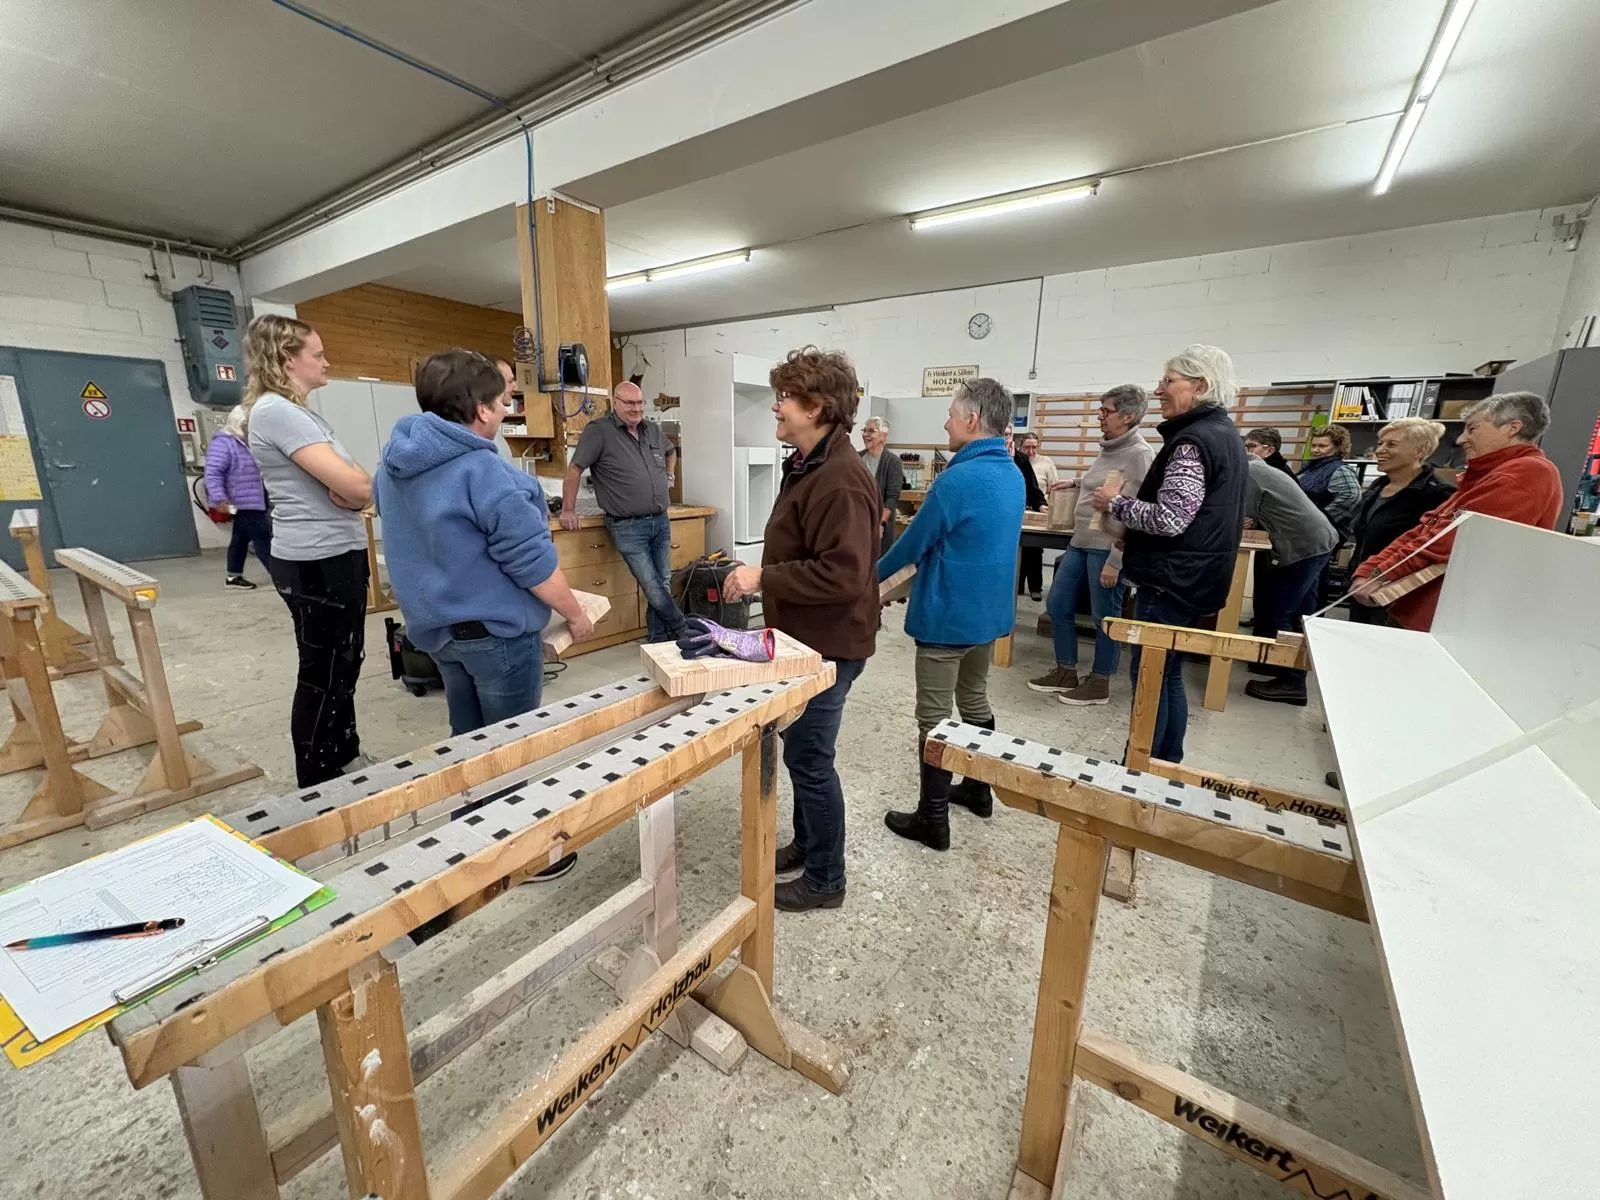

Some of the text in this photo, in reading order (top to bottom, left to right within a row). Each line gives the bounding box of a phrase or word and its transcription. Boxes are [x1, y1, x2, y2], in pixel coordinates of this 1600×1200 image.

[1200, 776, 1348, 825] Weikert Holzba
[536, 1045, 617, 1136] Weikert
[649, 953, 713, 1024] Holzbau
[1173, 1095, 1297, 1172] Weikert
